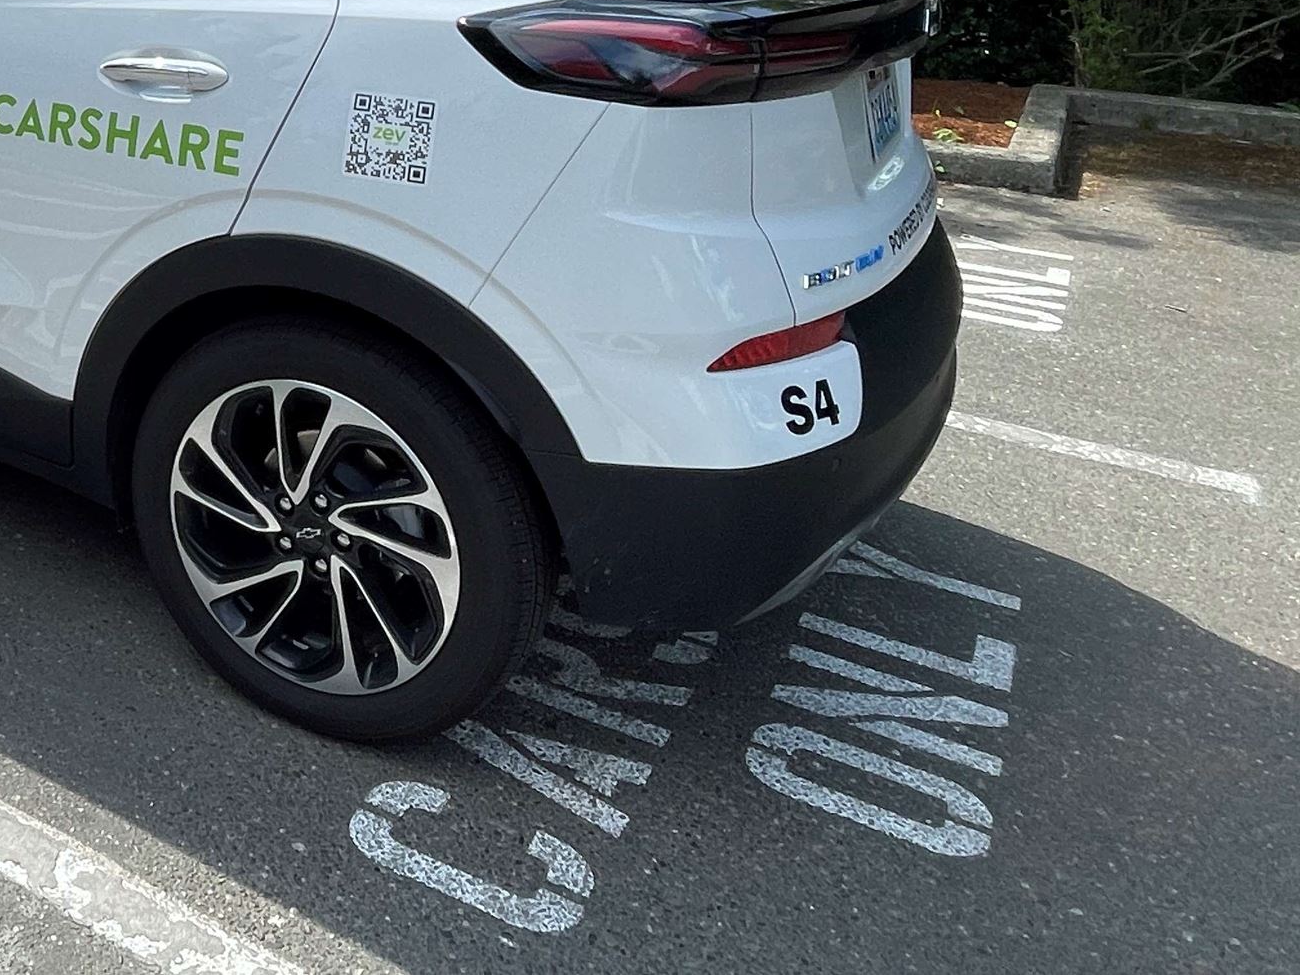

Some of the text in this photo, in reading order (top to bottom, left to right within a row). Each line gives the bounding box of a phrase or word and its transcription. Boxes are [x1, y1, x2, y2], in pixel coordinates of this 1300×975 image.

[372, 126, 406, 142] zev
[781, 379, 840, 436] S4
[744, 539, 1022, 857] ONLY
